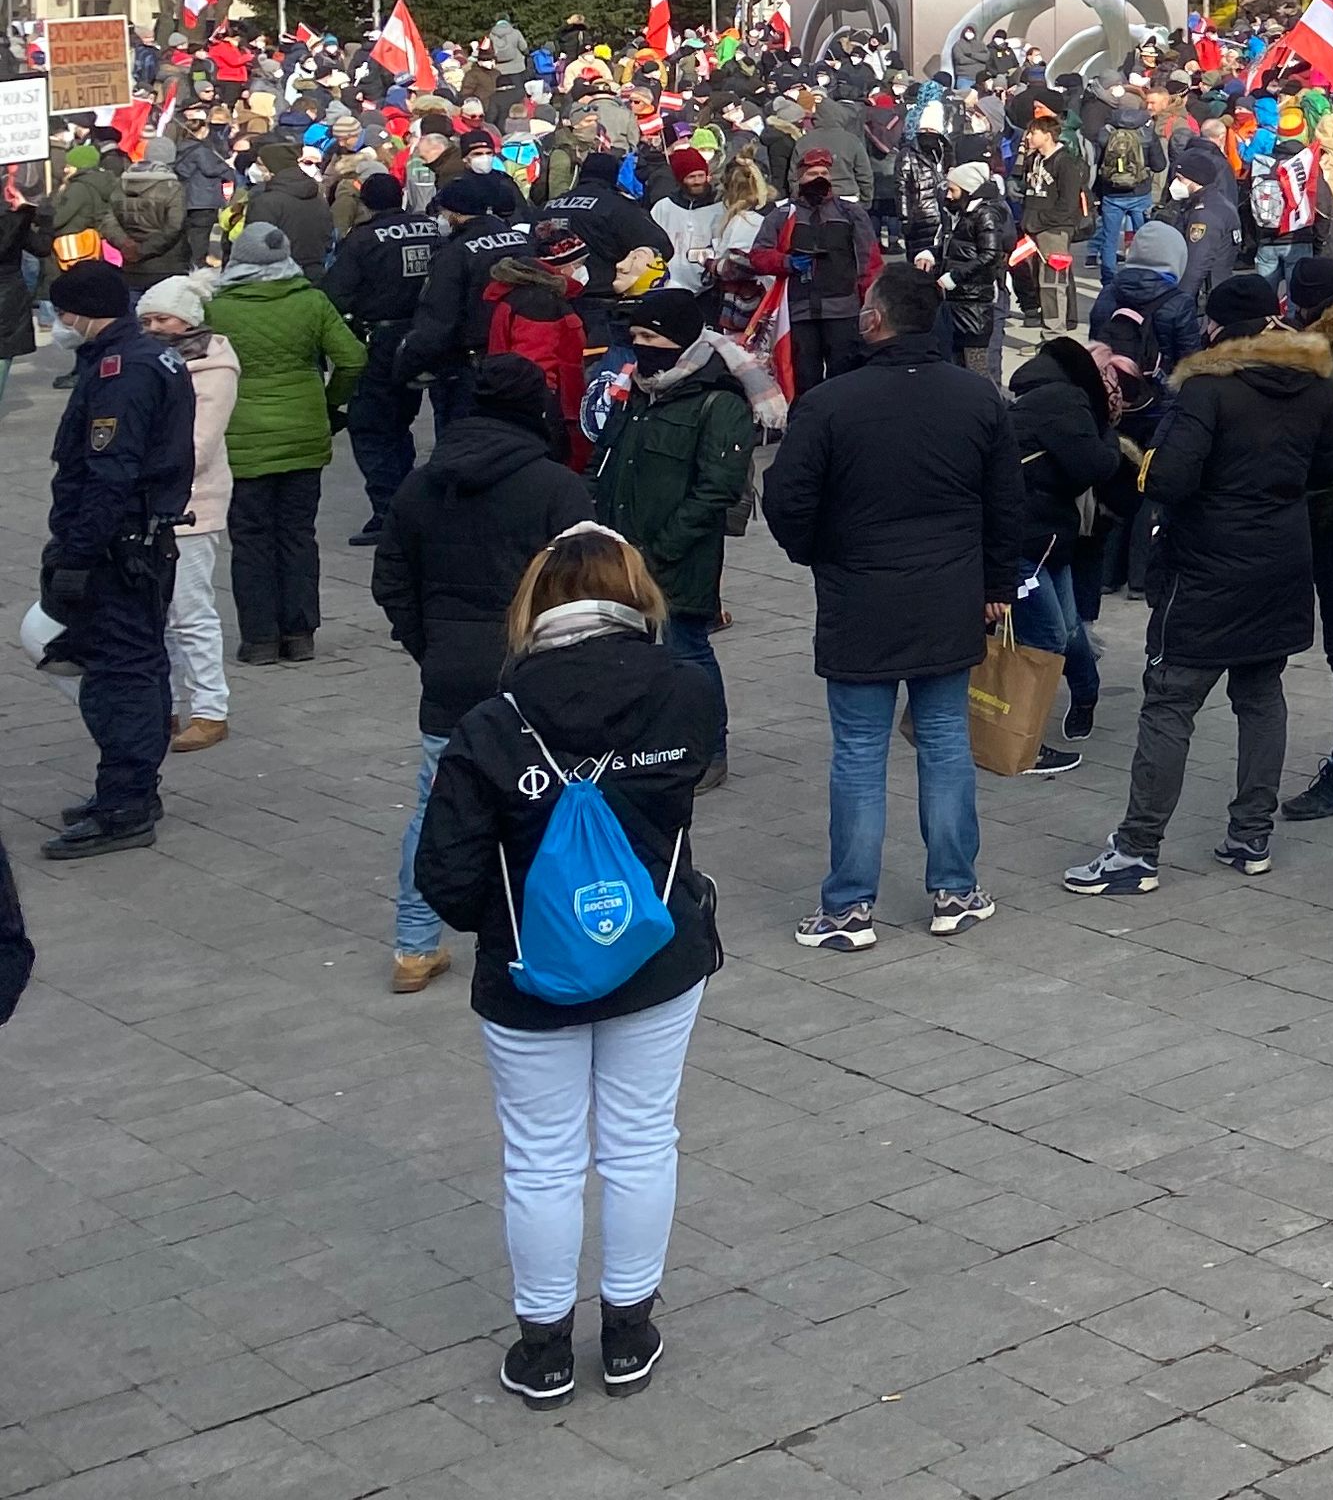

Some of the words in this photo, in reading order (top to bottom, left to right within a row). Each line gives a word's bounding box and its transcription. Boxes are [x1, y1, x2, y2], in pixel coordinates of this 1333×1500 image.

[544, 196, 599, 210] POLIZEI
[375, 221, 438, 242] POLIZE
[611, 755, 627, 770] &
[631, 747, 689, 768] Naimer
